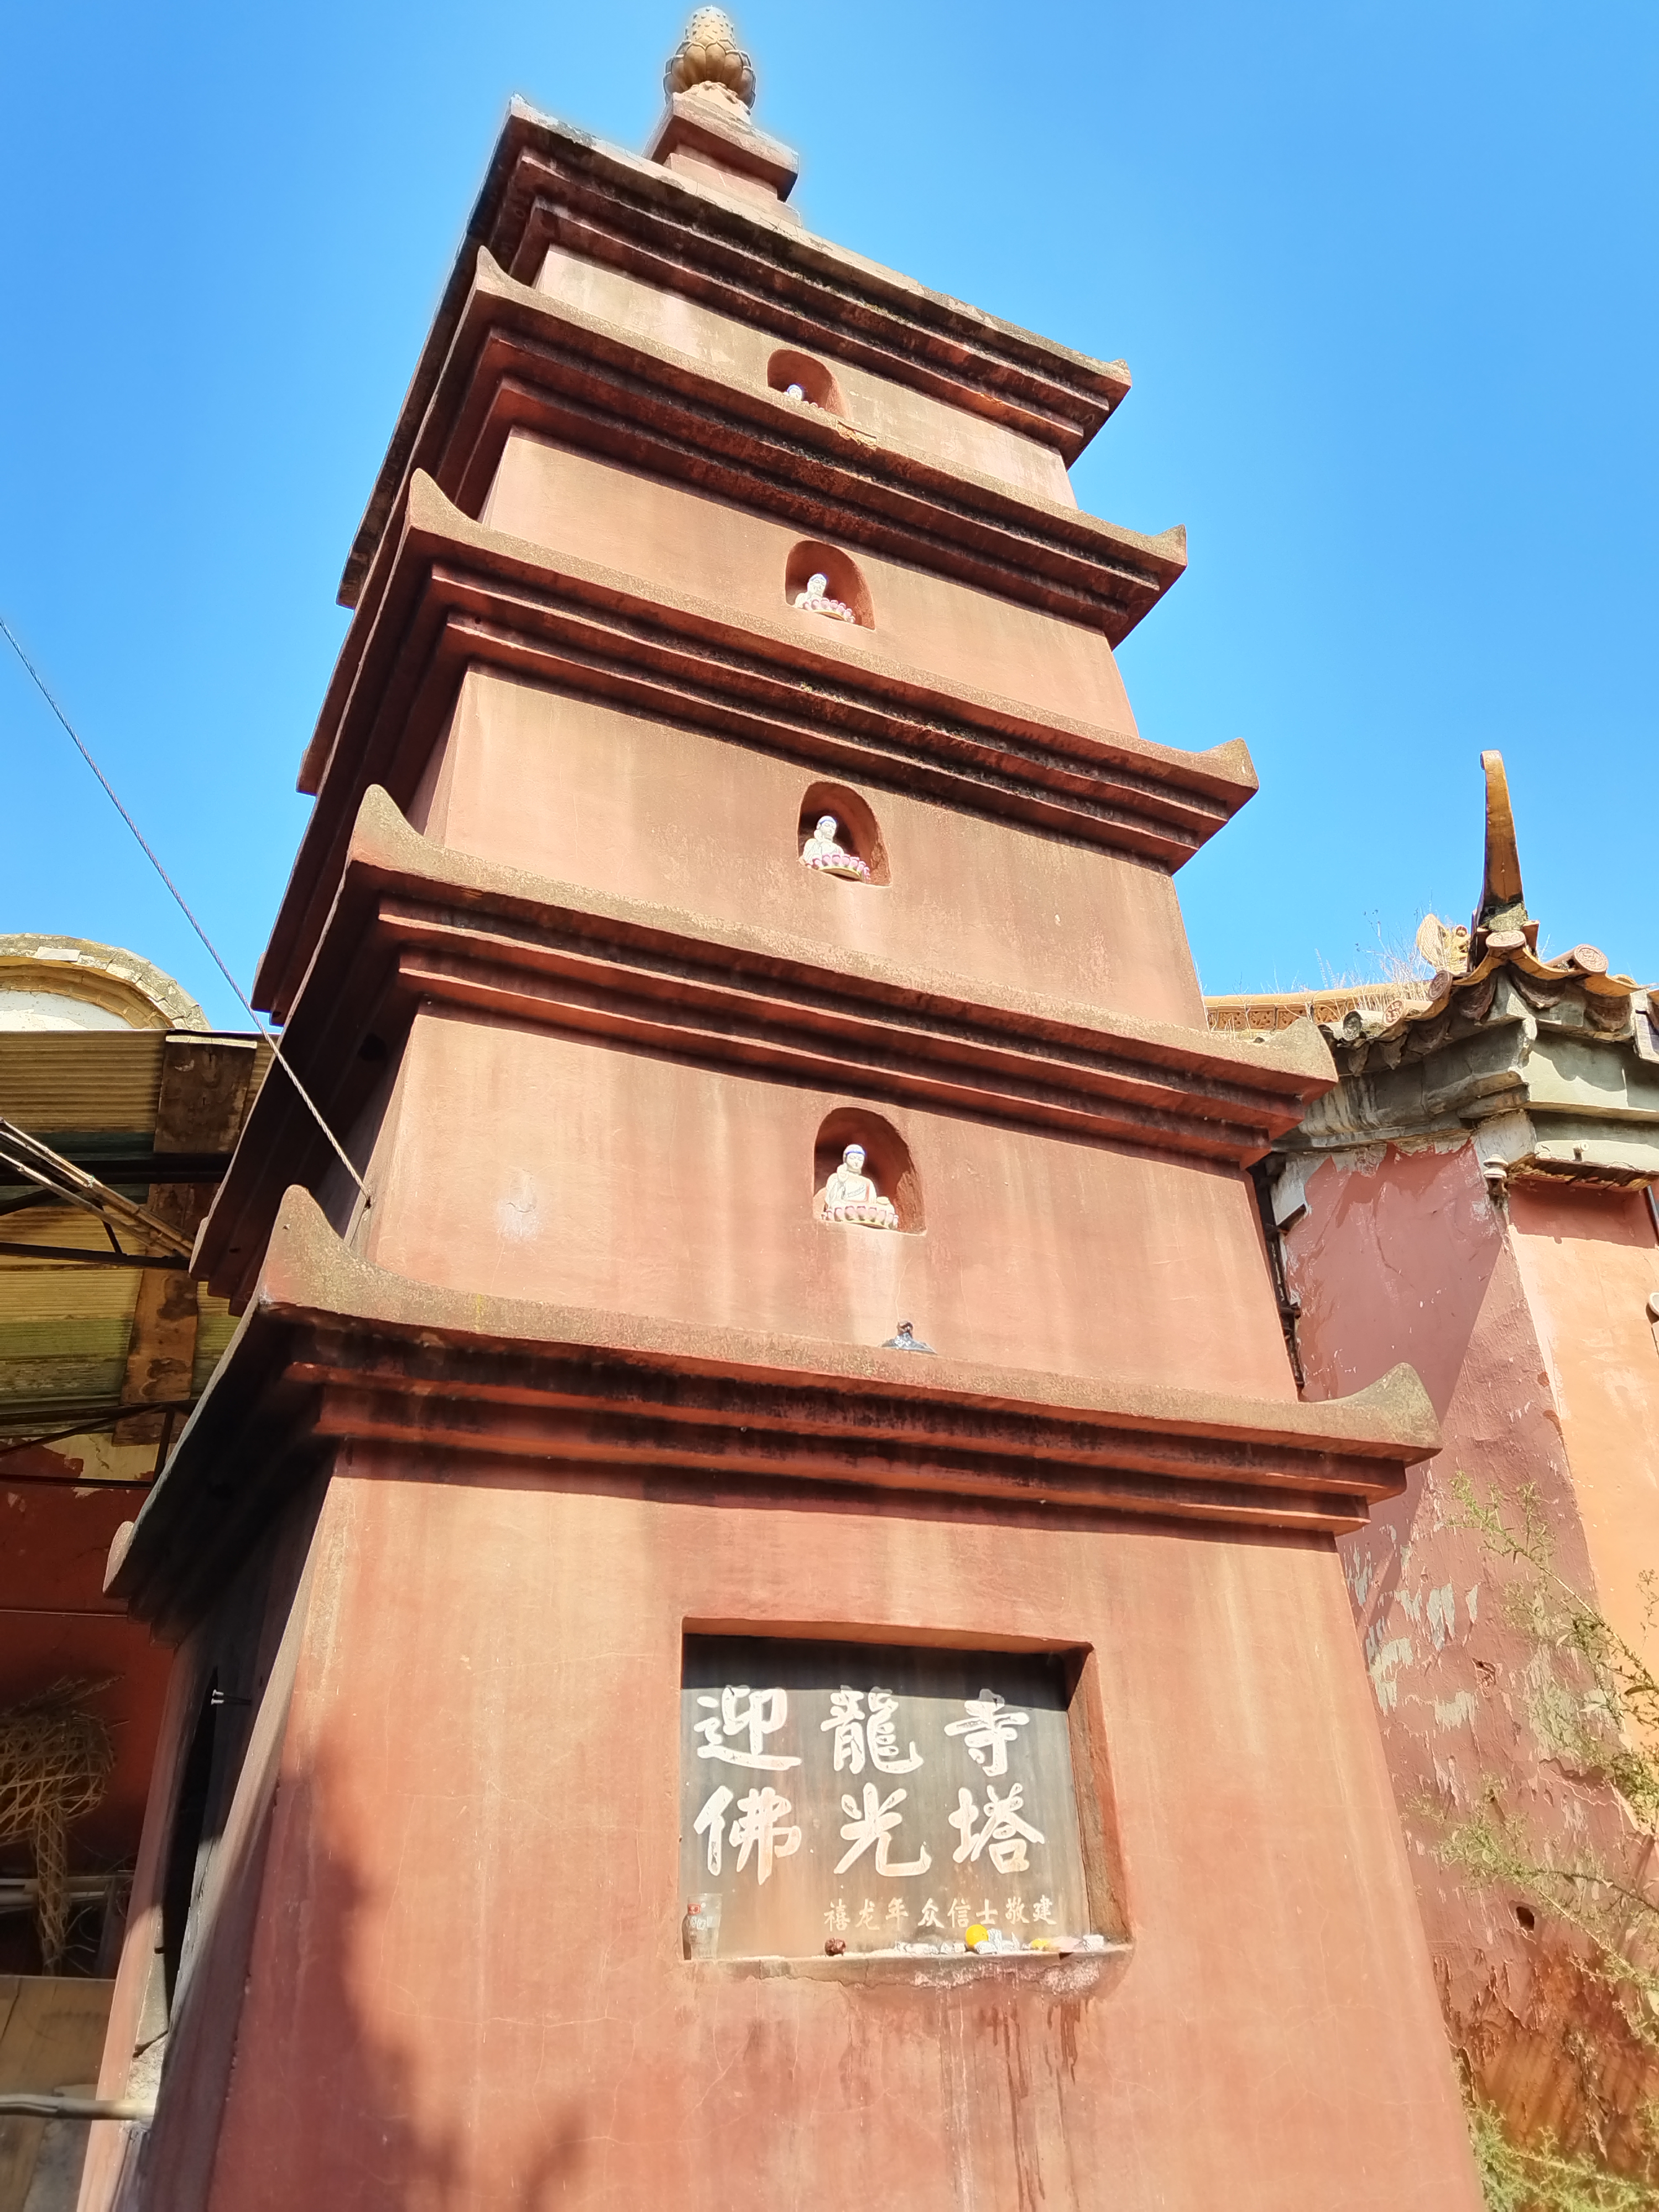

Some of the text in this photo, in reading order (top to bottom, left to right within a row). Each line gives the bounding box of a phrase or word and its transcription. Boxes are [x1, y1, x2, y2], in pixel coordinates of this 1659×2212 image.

[693, 1684, 1030, 1777] 迎龍寺
[693, 1782, 1045, 1885] 佛光塔
